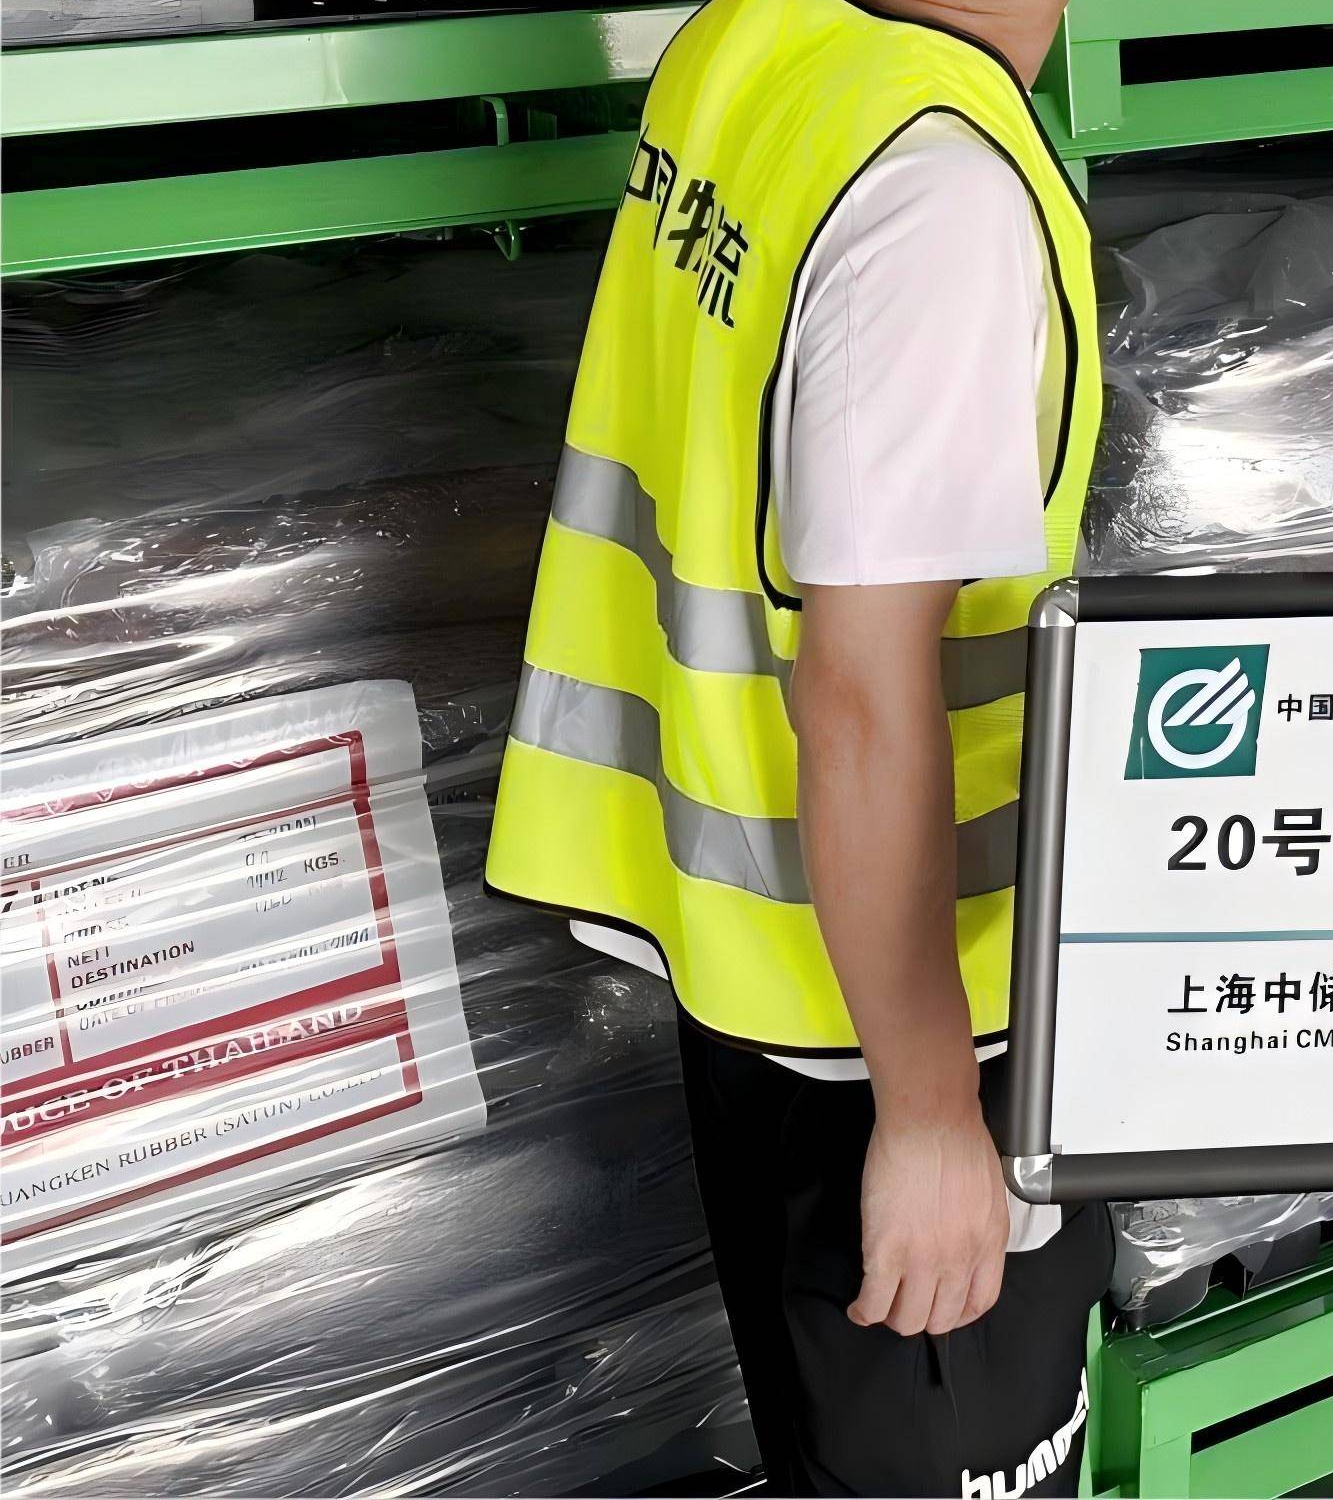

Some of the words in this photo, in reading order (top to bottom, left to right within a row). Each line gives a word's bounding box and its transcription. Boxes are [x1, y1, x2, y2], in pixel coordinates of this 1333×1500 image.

[71, 940, 196, 990] DESTINATION
[0, 1036, 55, 1065] UBBER
[1166, 1029, 1288, 1055] Shanghai
[101, 1066, 153, 1101] OF
[0, 1158, 110, 1207] UANGKEN
[118, 1127, 208, 1169] RUBBER
[215, 1096, 302, 1137] (SATUN)
